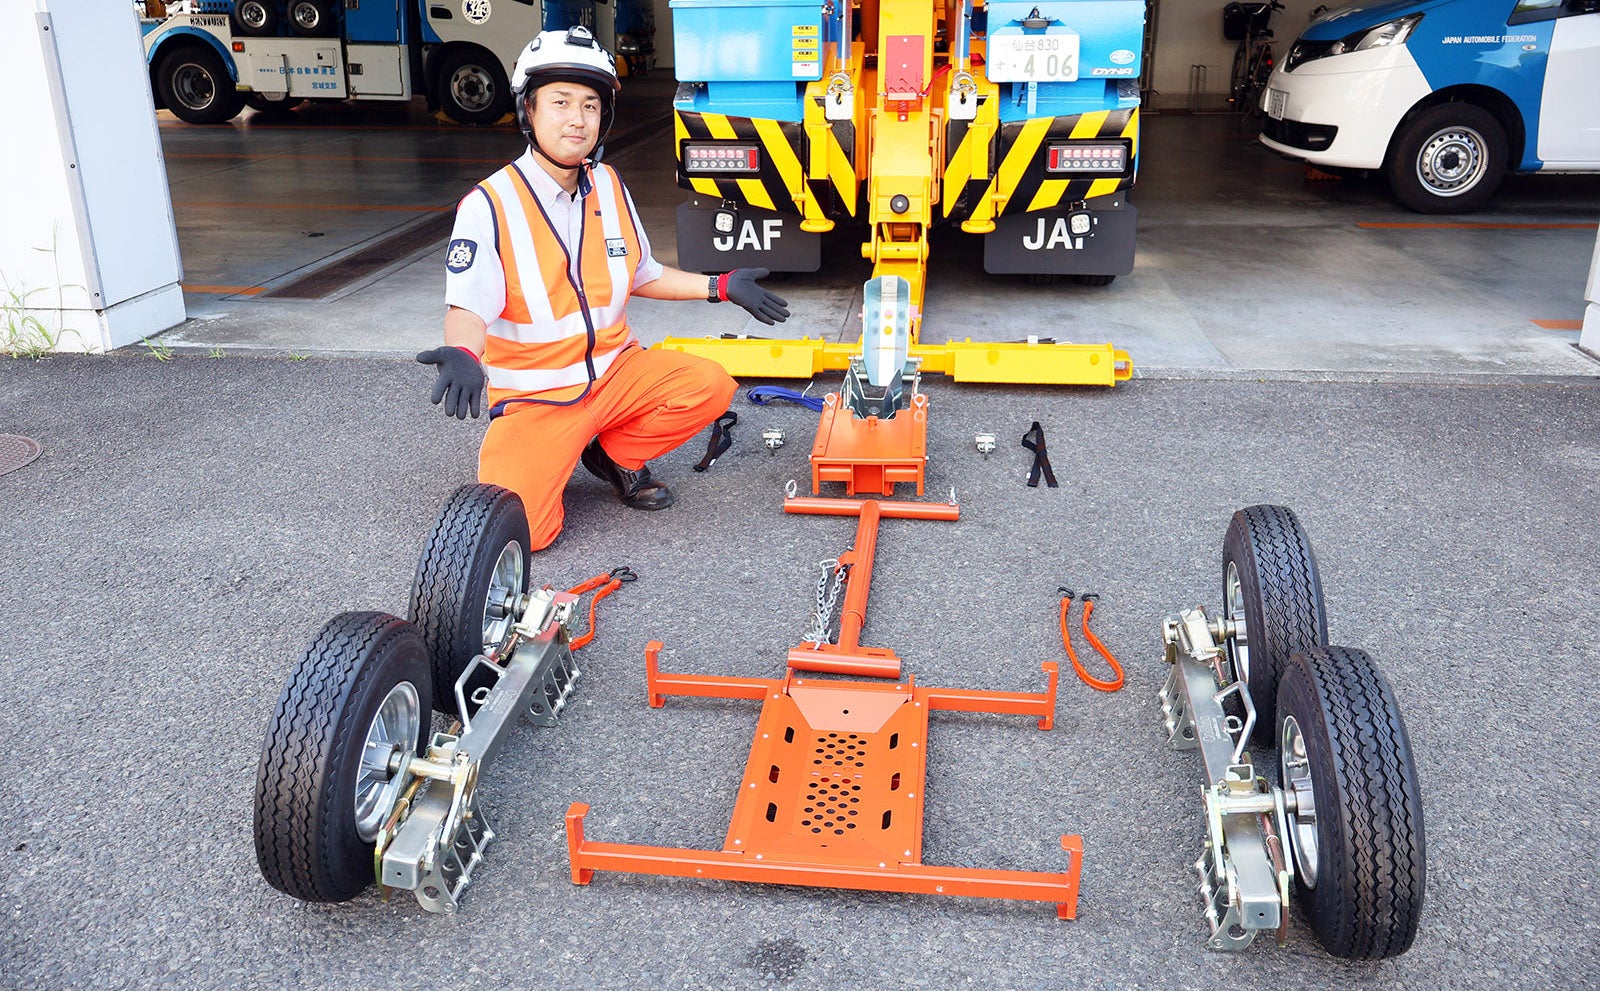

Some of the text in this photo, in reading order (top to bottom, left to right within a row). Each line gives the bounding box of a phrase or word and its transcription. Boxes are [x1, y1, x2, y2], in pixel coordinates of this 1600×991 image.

[190, 17, 226, 26] CENTURY
[1463, 36, 1500, 44] AUTOMOBILE
[1092, 67, 1133, 76] DYNA
